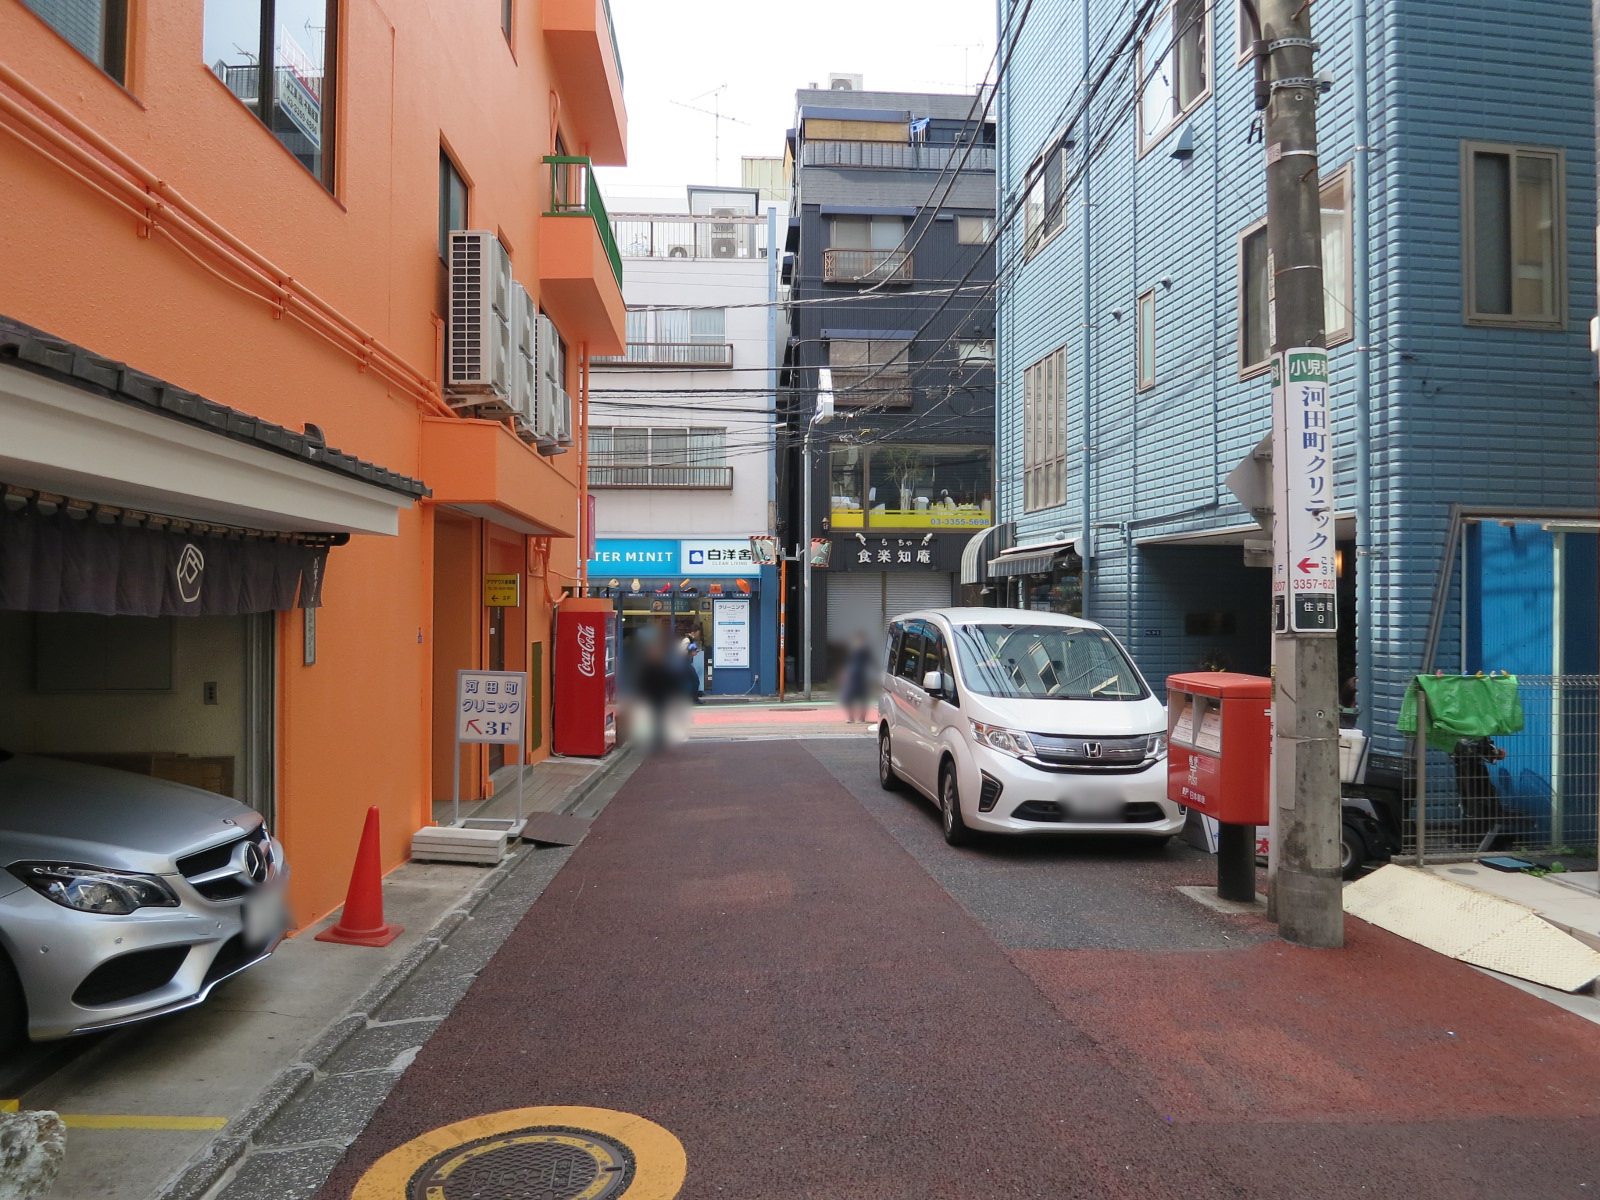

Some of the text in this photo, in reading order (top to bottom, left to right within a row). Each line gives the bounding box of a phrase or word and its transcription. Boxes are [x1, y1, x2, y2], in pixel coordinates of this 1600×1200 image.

[1301, 386, 1331, 551] 河田町クリニック
[626, 551, 674, 562] MINIT
[857, 549, 931, 564] 食楽知庵
[1317, 614, 1325, 624] 9
[465, 680, 519, 695] 河田町
[462, 698, 520, 713] クリニック
[485, 721, 513, 736] 3F
